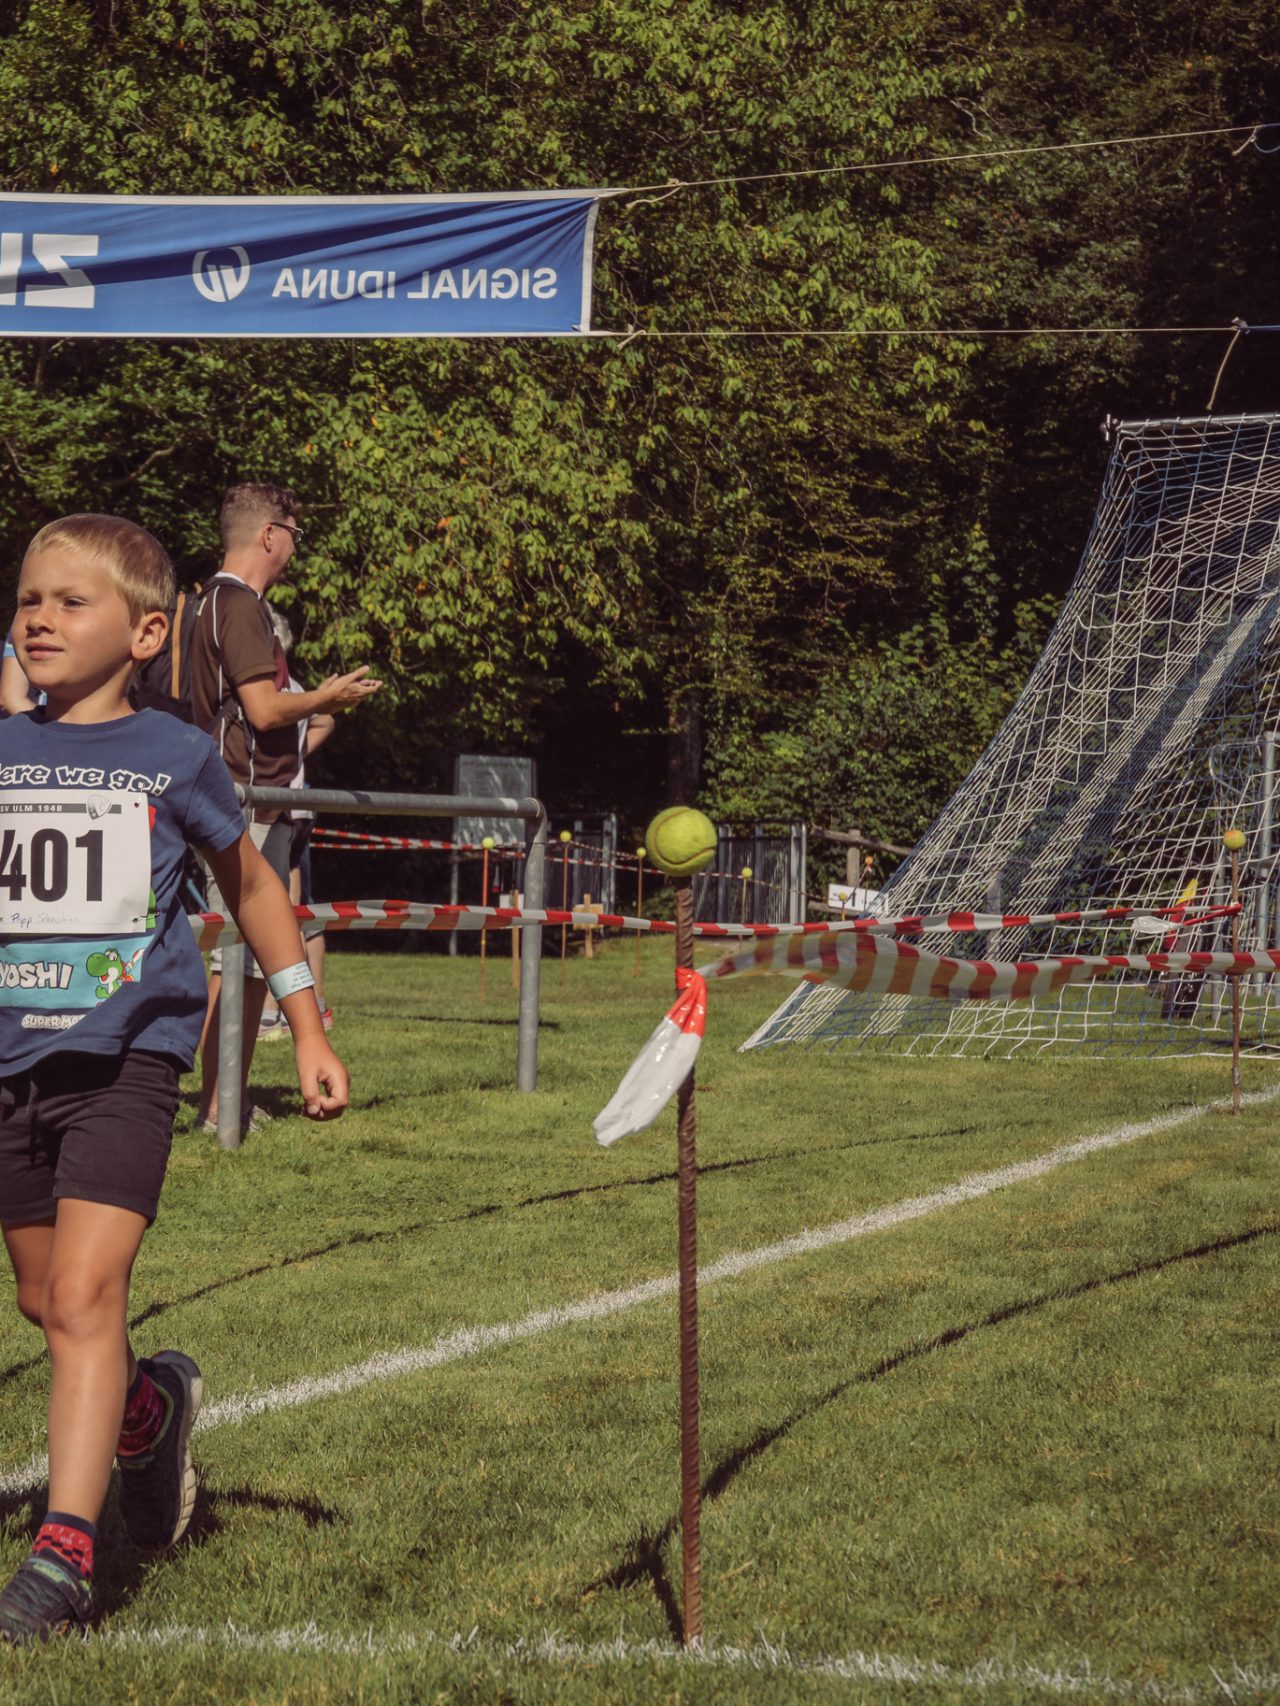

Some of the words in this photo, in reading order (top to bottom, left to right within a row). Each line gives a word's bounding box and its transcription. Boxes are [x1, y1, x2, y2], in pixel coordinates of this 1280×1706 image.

[56, 765, 105, 787] we
[108, 769, 171, 796] go!
[0, 804, 10, 812] SV
[13, 804, 33, 812] ULM
